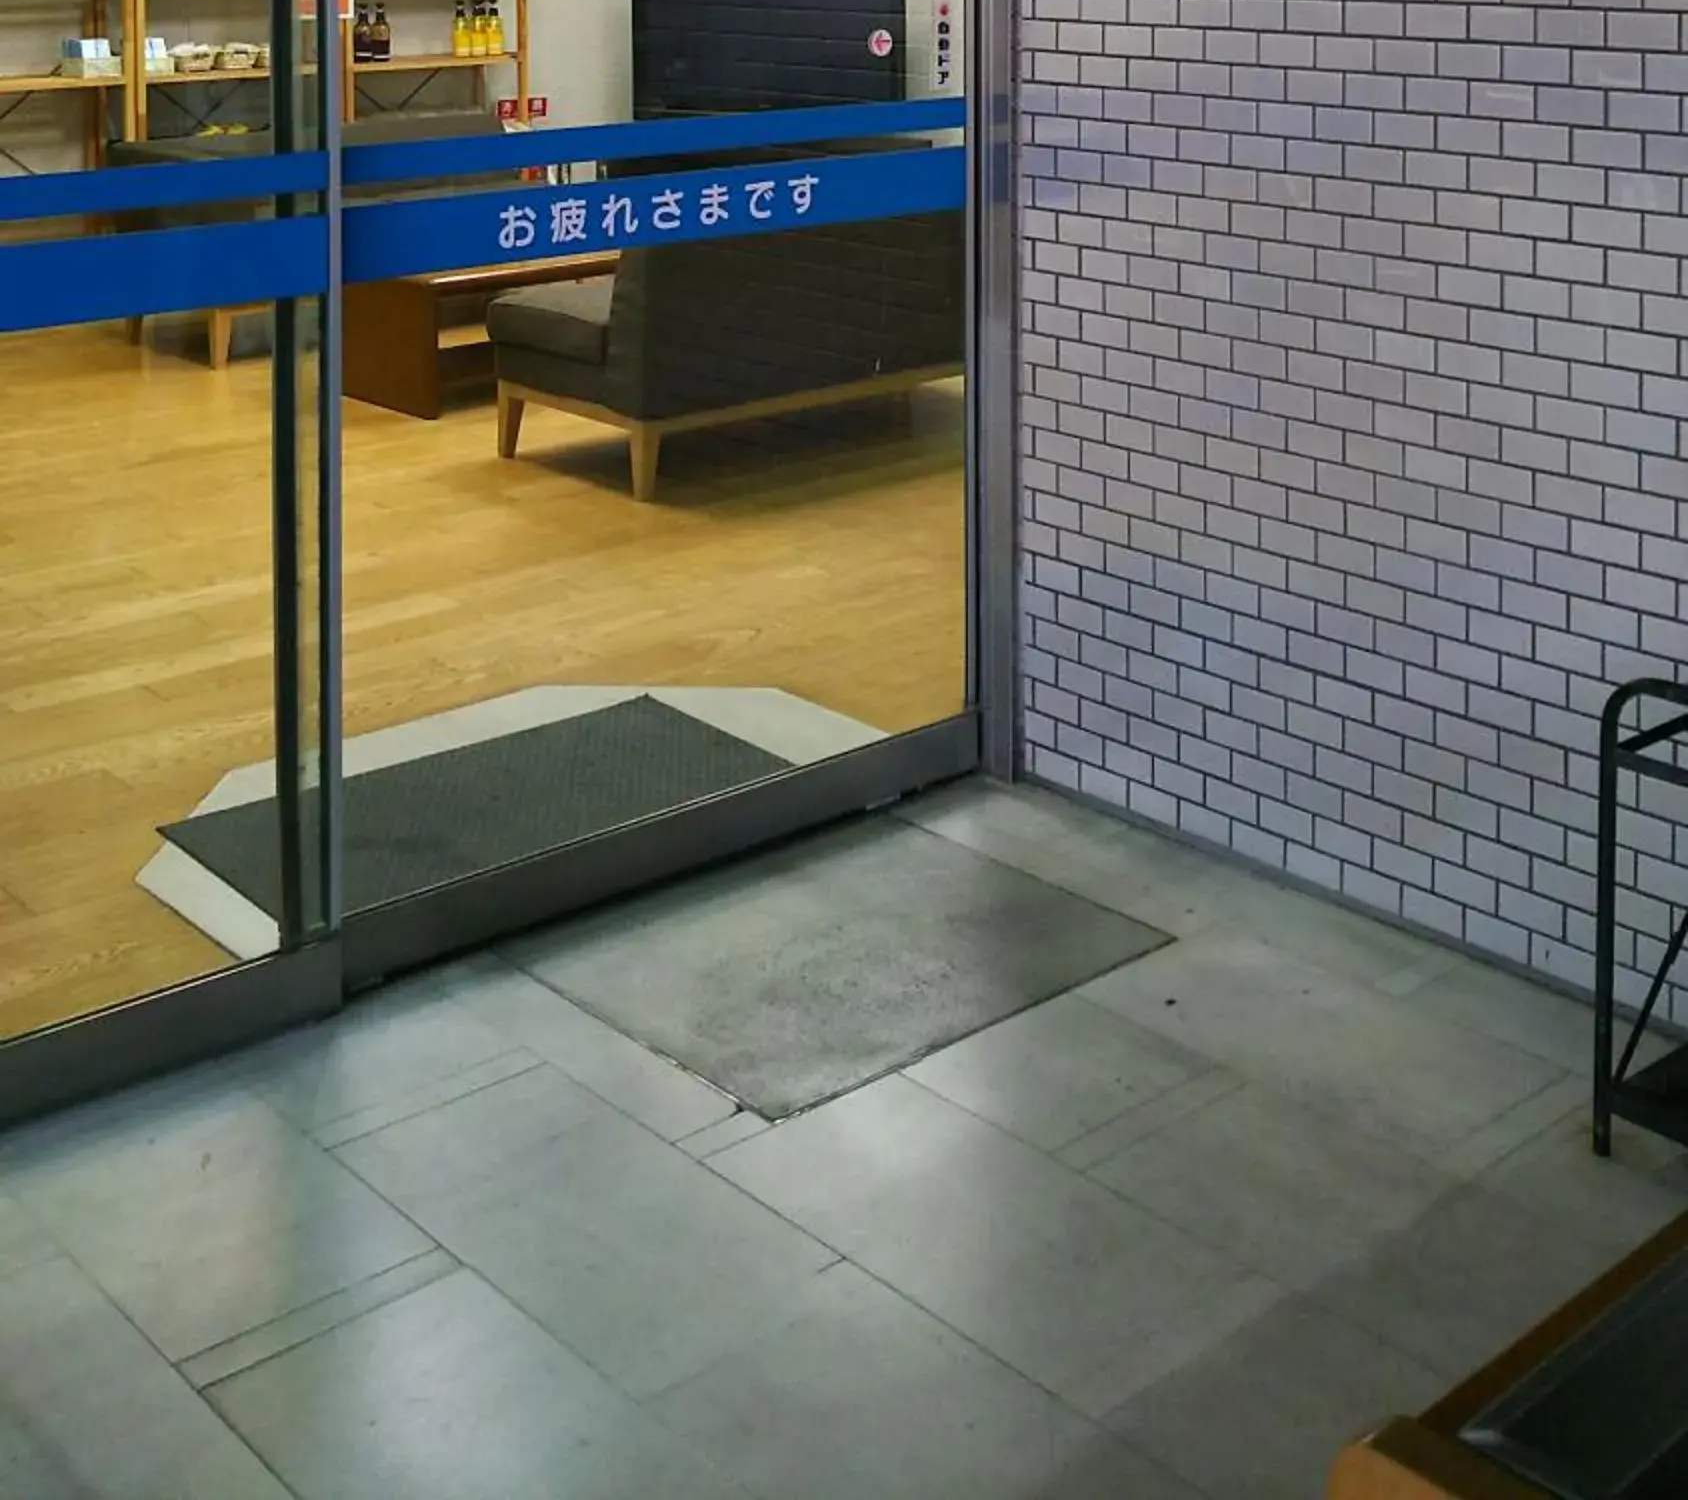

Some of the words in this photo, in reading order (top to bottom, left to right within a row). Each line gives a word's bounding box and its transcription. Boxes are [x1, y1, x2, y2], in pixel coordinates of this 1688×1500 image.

[498, 174, 820, 249] お疲れさまです
